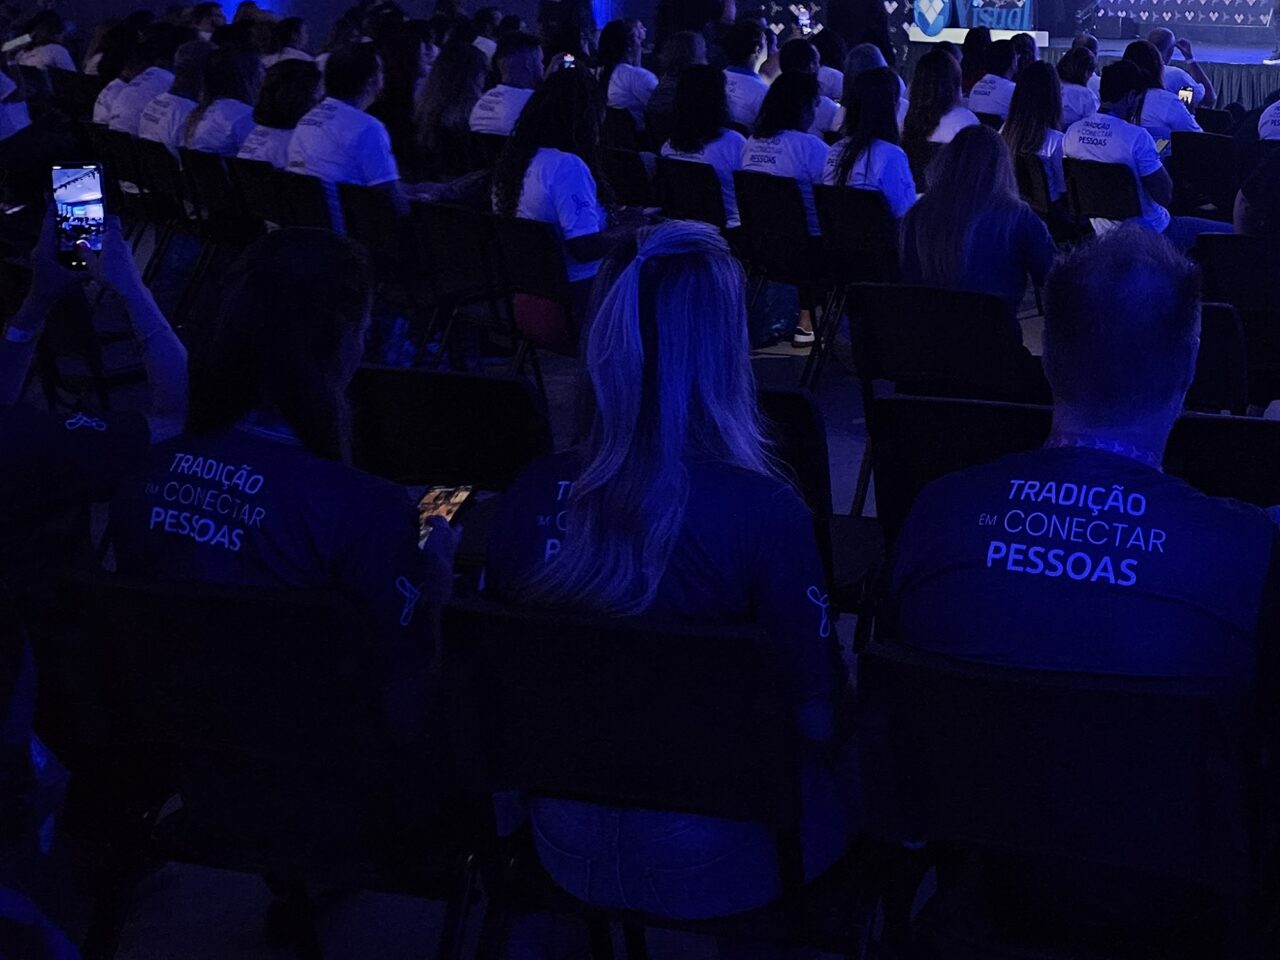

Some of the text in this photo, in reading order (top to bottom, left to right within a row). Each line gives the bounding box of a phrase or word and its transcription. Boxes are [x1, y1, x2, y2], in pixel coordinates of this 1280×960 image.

[1079, 137, 1107, 146] PESSOAS
[169, 452, 264, 495] TRADIÇÃO
[163, 481, 267, 529] CONECTAR
[1008, 479, 1147, 516] TRADIÇÃO
[150, 506, 245, 552] PESSOAS
[978, 509, 1167, 553] EM CONECTAR
[986, 540, 1139, 587] PESSOAS
